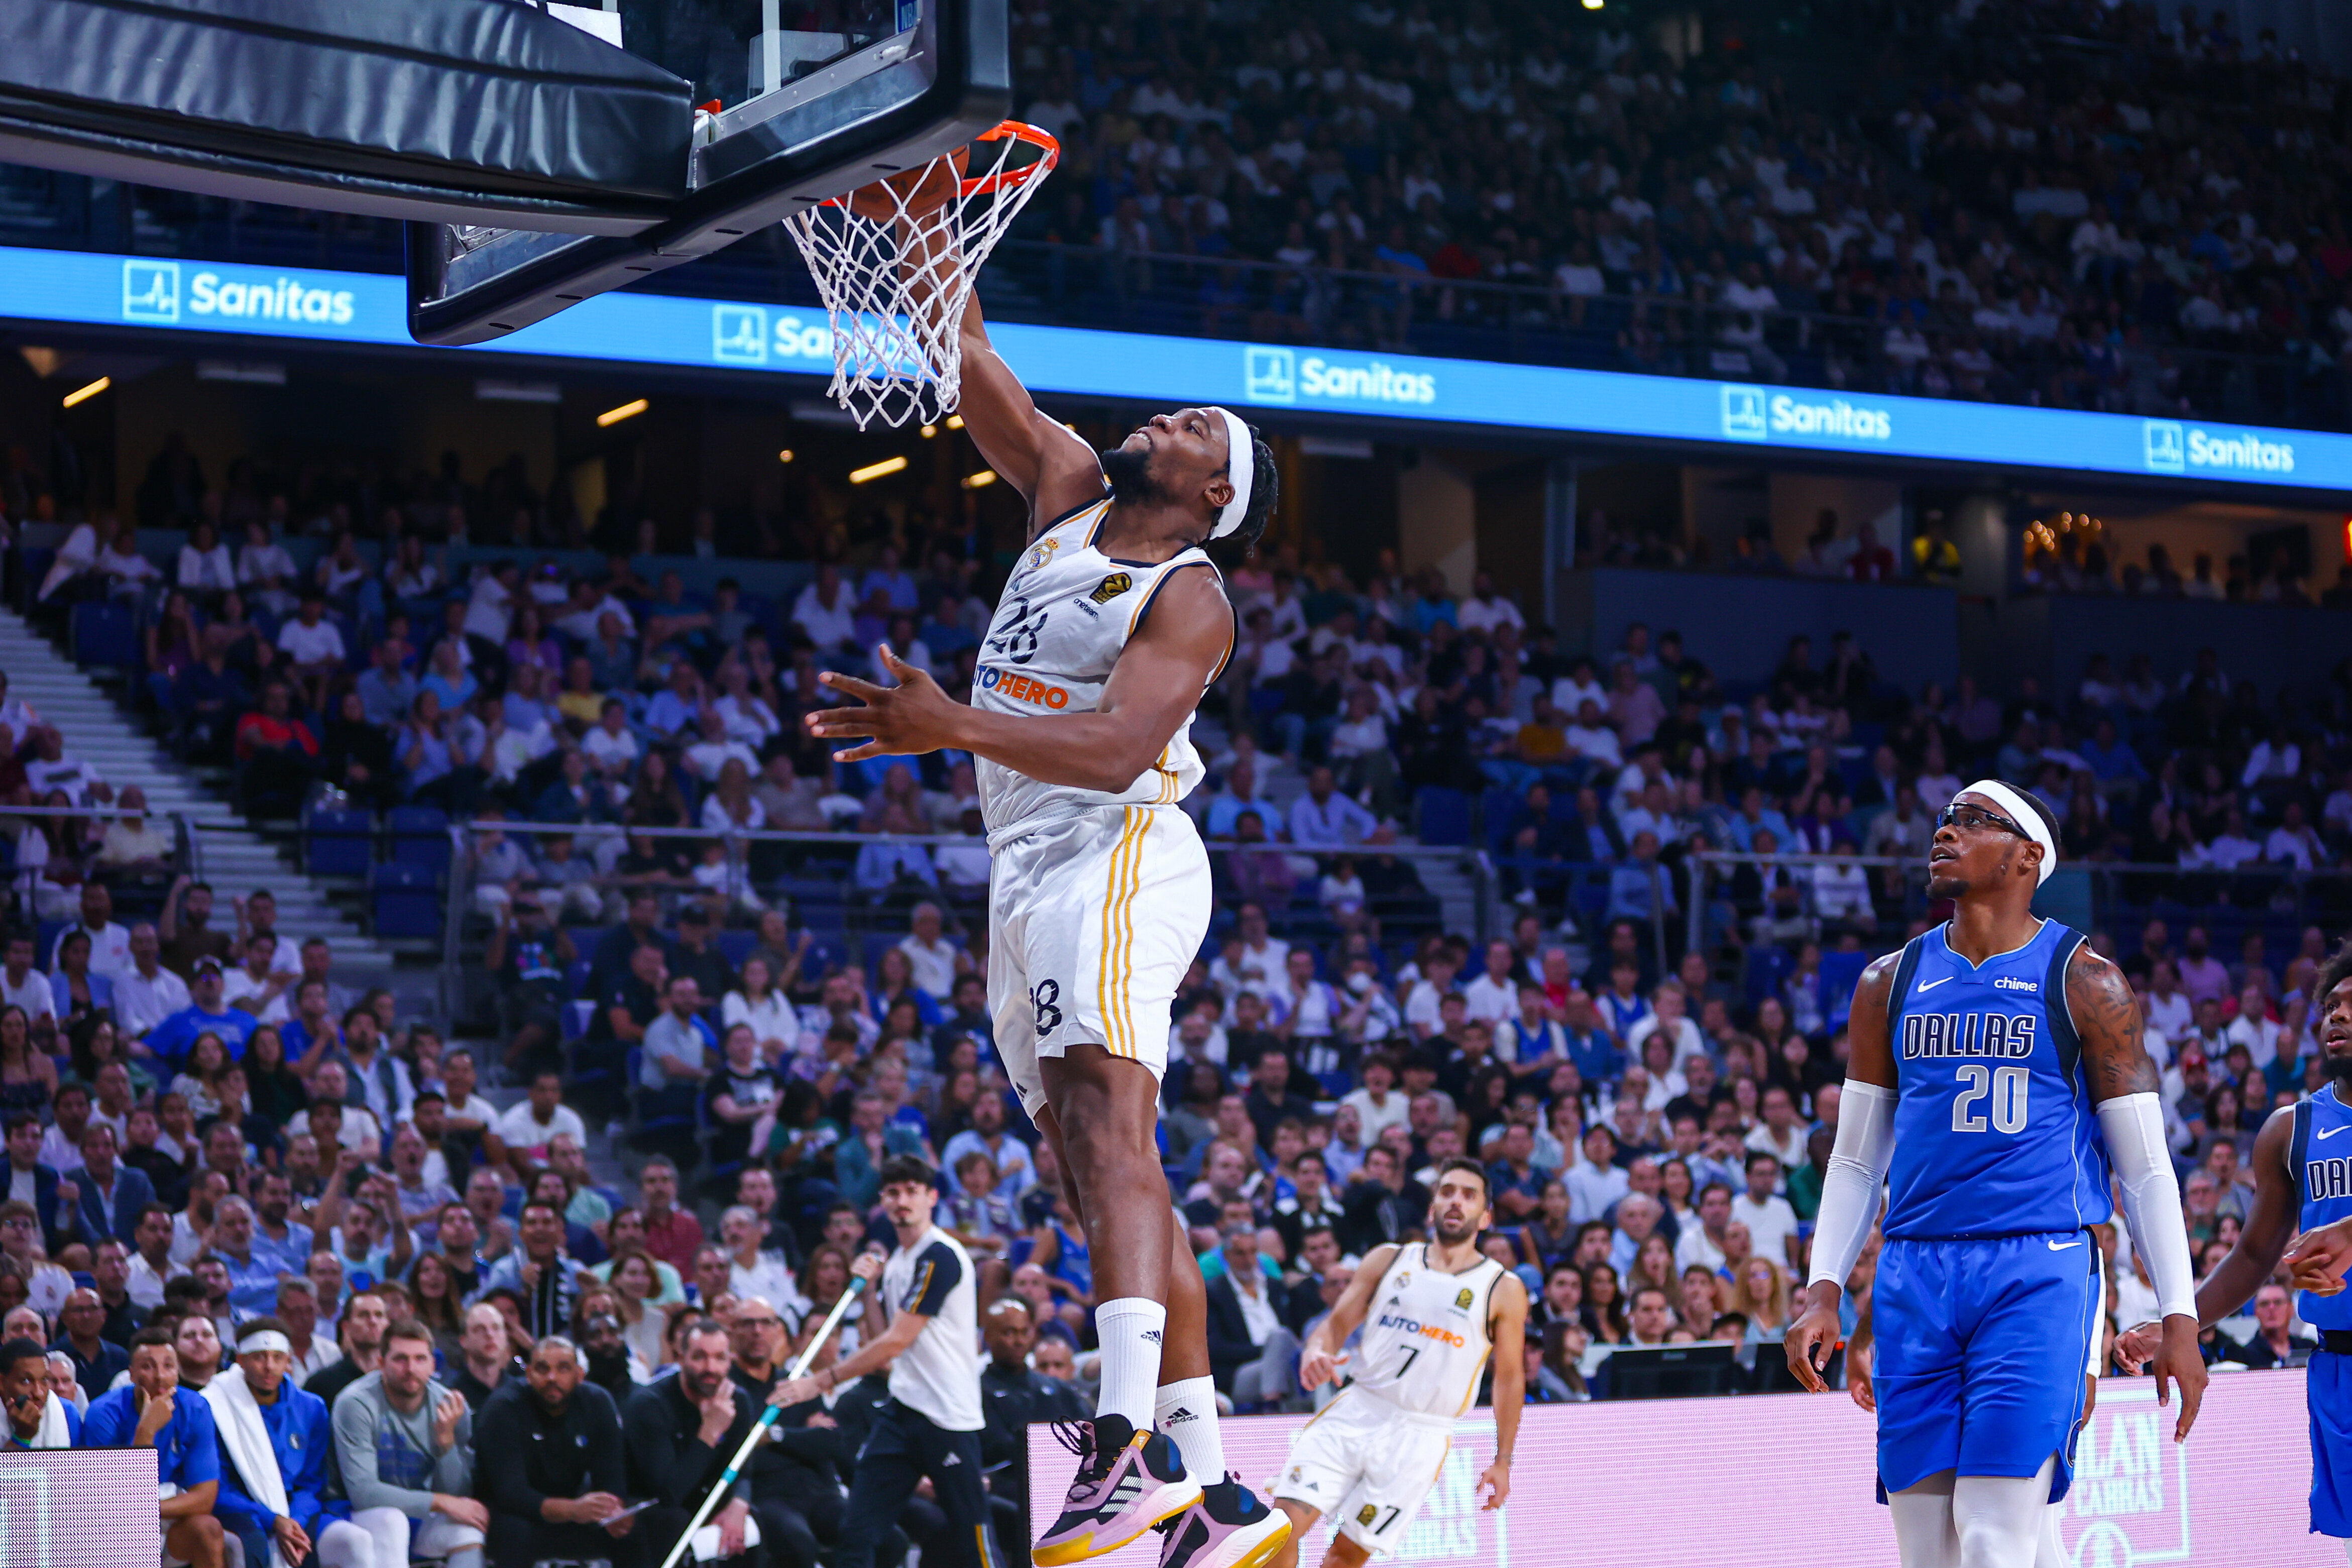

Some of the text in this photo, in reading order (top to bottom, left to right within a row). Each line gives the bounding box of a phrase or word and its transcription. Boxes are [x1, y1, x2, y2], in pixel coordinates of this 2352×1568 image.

[190, 272, 355, 324] Sanitas
[1300, 357, 1435, 404] Sanitas
[1770, 395, 1892, 441] Sanitas
[2187, 428, 2294, 473] Sanitas
[985, 597, 1048, 664] 28
[1029, 978, 1062, 1036] 8
[1994, 976, 2037, 992] chime
[1903, 1013, 2036, 1060] DALLAS
[1952, 1064, 2030, 1134] 20
[1379, 1314, 1465, 1348] AUTOHERO
[1396, 1345, 1420, 1379] 7
[1171, 1414, 1199, 1424] didas
[1375, 1505, 1400, 1535] 7
